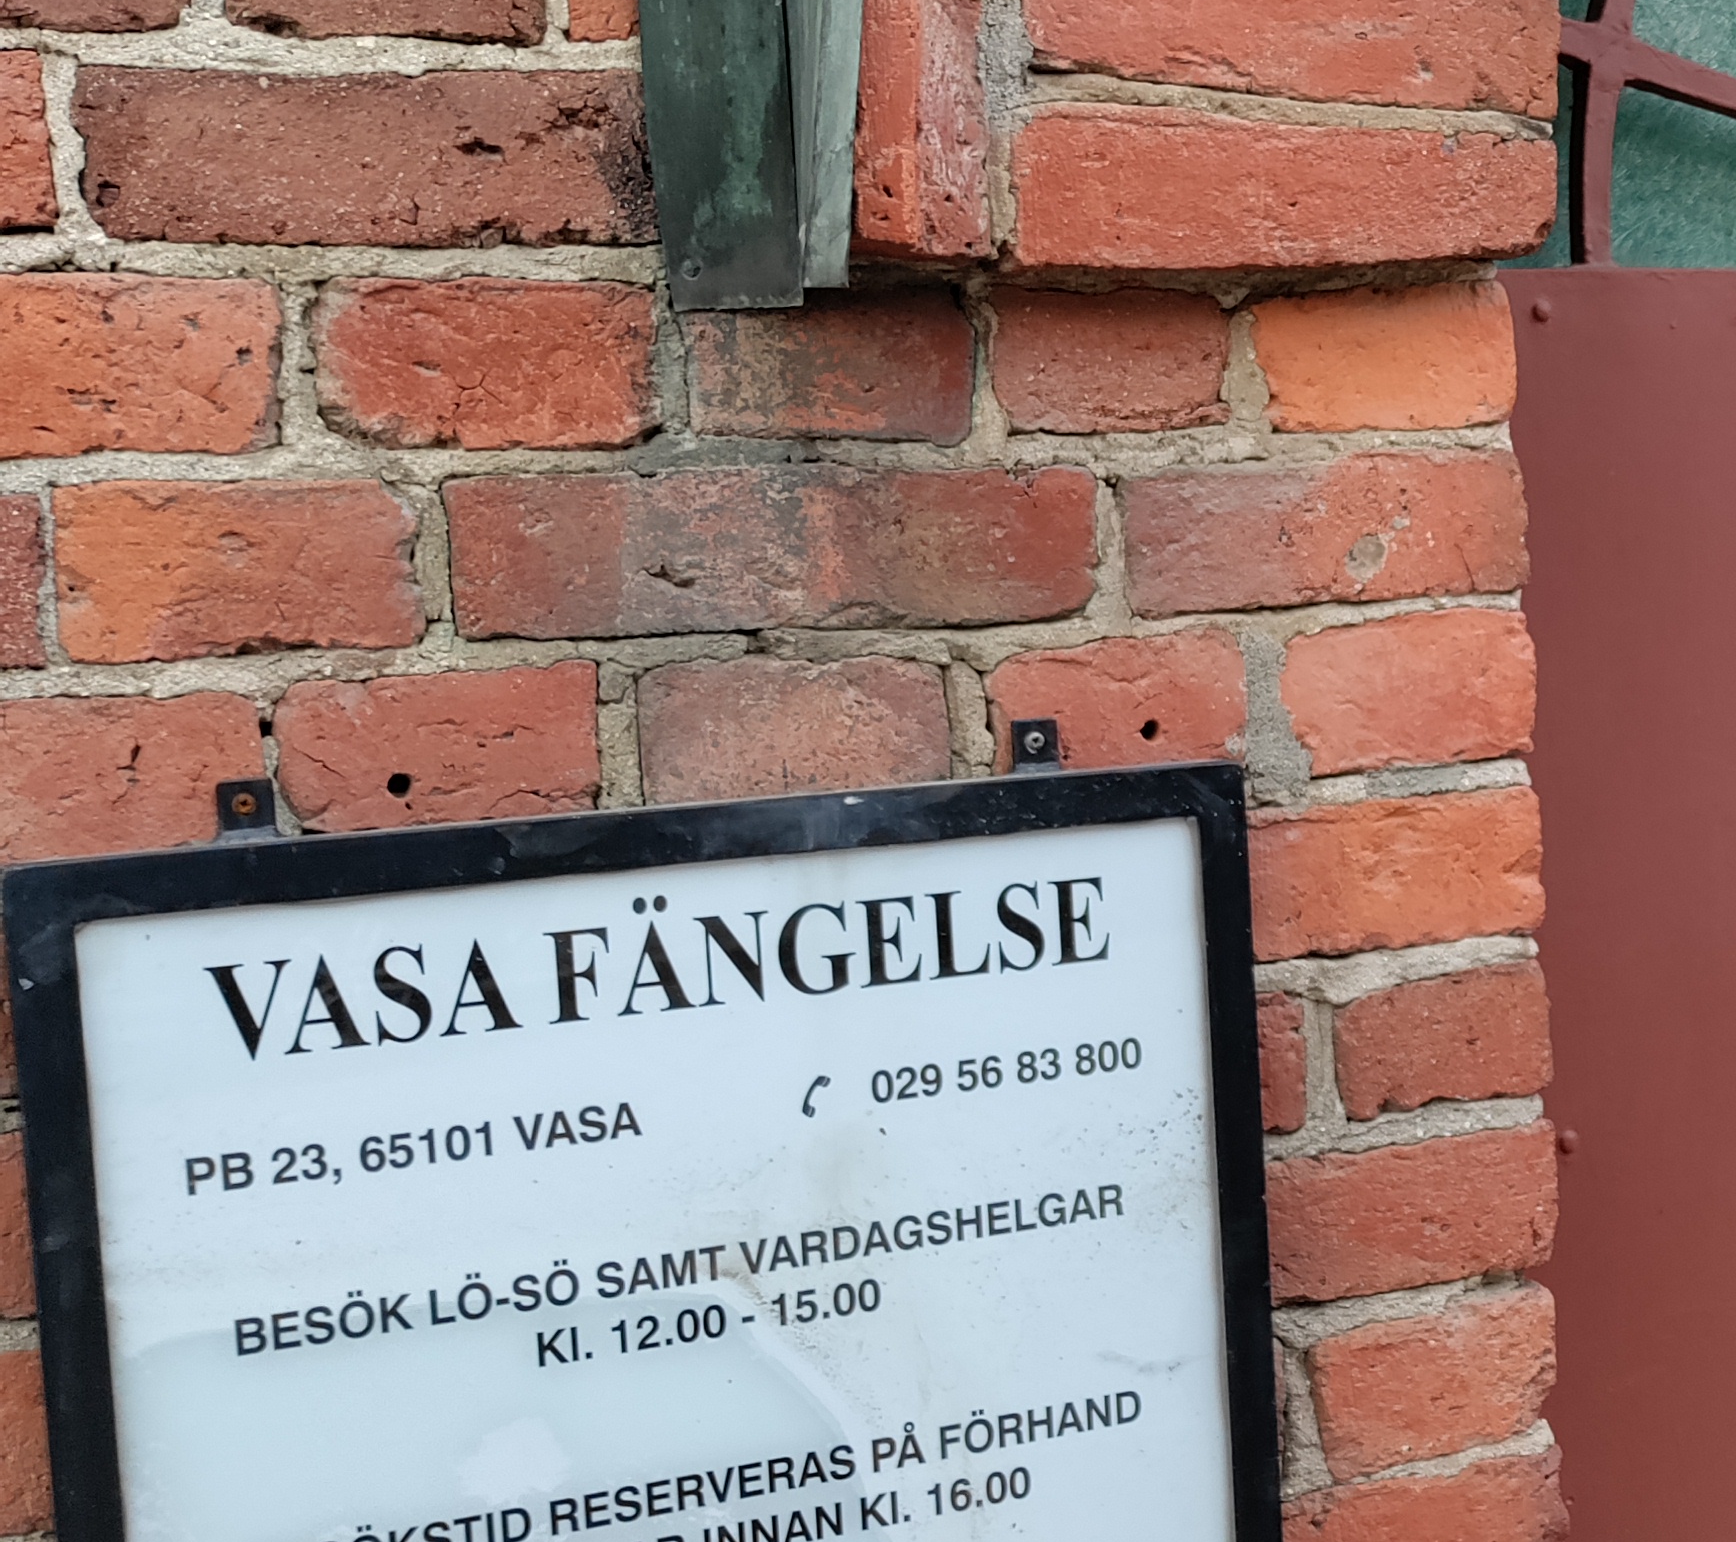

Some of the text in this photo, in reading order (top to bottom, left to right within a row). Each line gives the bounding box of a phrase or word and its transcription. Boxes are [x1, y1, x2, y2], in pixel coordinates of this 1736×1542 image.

[206, 877, 1112, 1061] VASA FÄNGELSE
[871, 1037, 1142, 1104] 029 56 83 800
[185, 1102, 643, 1196] PB 23, 65101 VASA
[234, 1184, 1124, 1357] BESÖK LÖ-SÖ SAMT VARDAGSHELGAR
[611, 1304, 727, 1354] 12.00
[770, 1278, 881, 1327] 15.00
[550, 1444, 855, 1537] RESERVERAS
[871, 1421, 926, 1474] PÅ
[939, 1390, 1142, 1460] FÖRHAND
[927, 1466, 1031, 1516] 16.00
